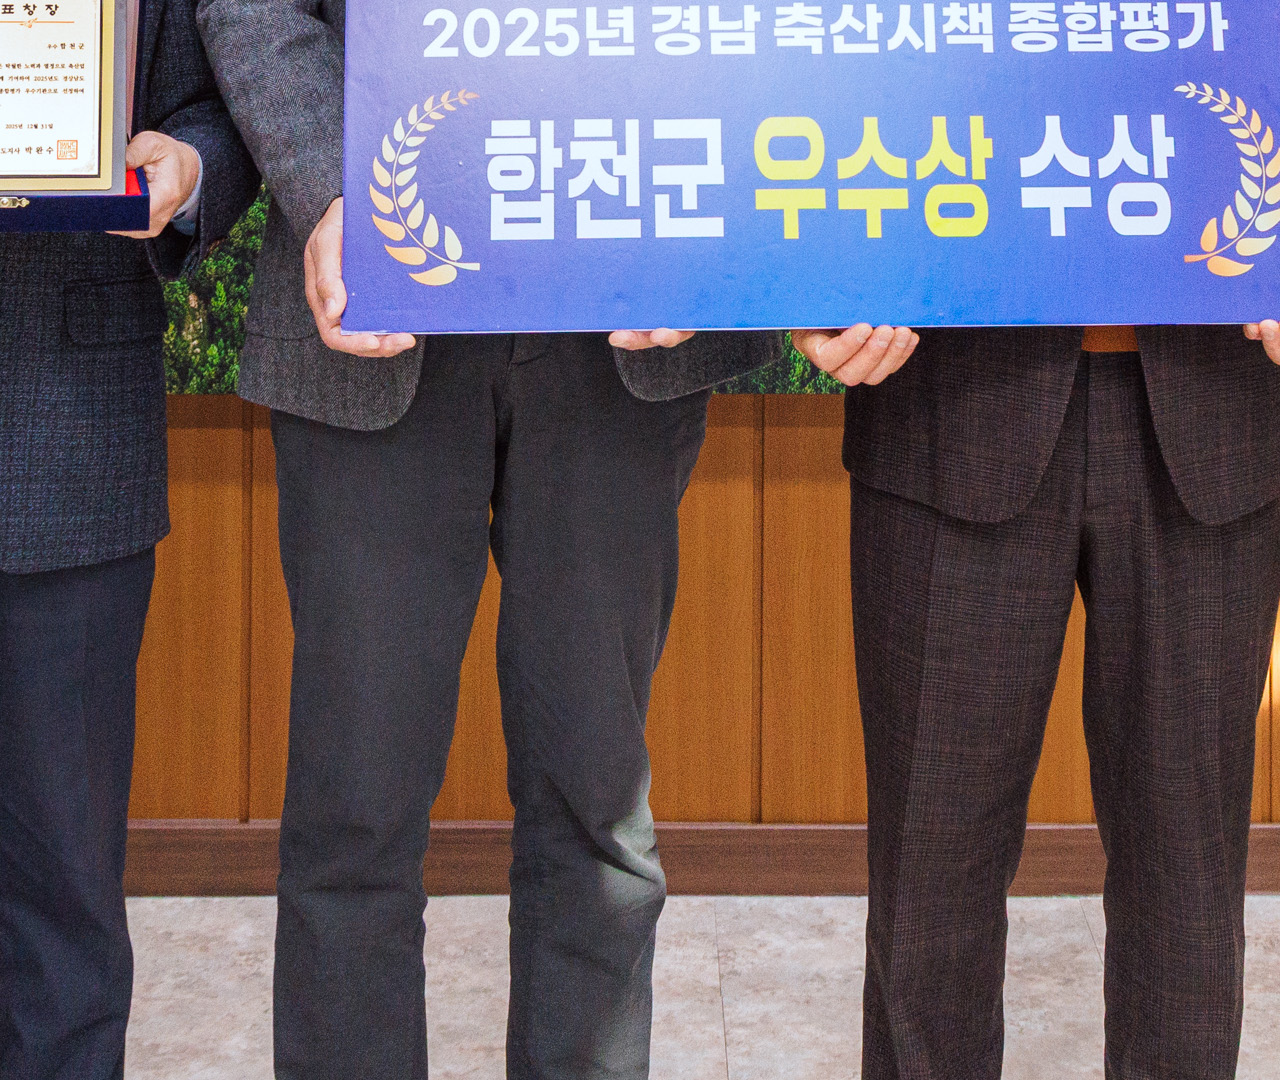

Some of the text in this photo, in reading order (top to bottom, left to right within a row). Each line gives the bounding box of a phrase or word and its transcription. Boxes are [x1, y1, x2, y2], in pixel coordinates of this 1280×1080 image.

[423, 2, 1230, 59] 2025년 경남 축산시책 종합평가
[486, 115, 1176, 242] 합천군 우수상 수상
